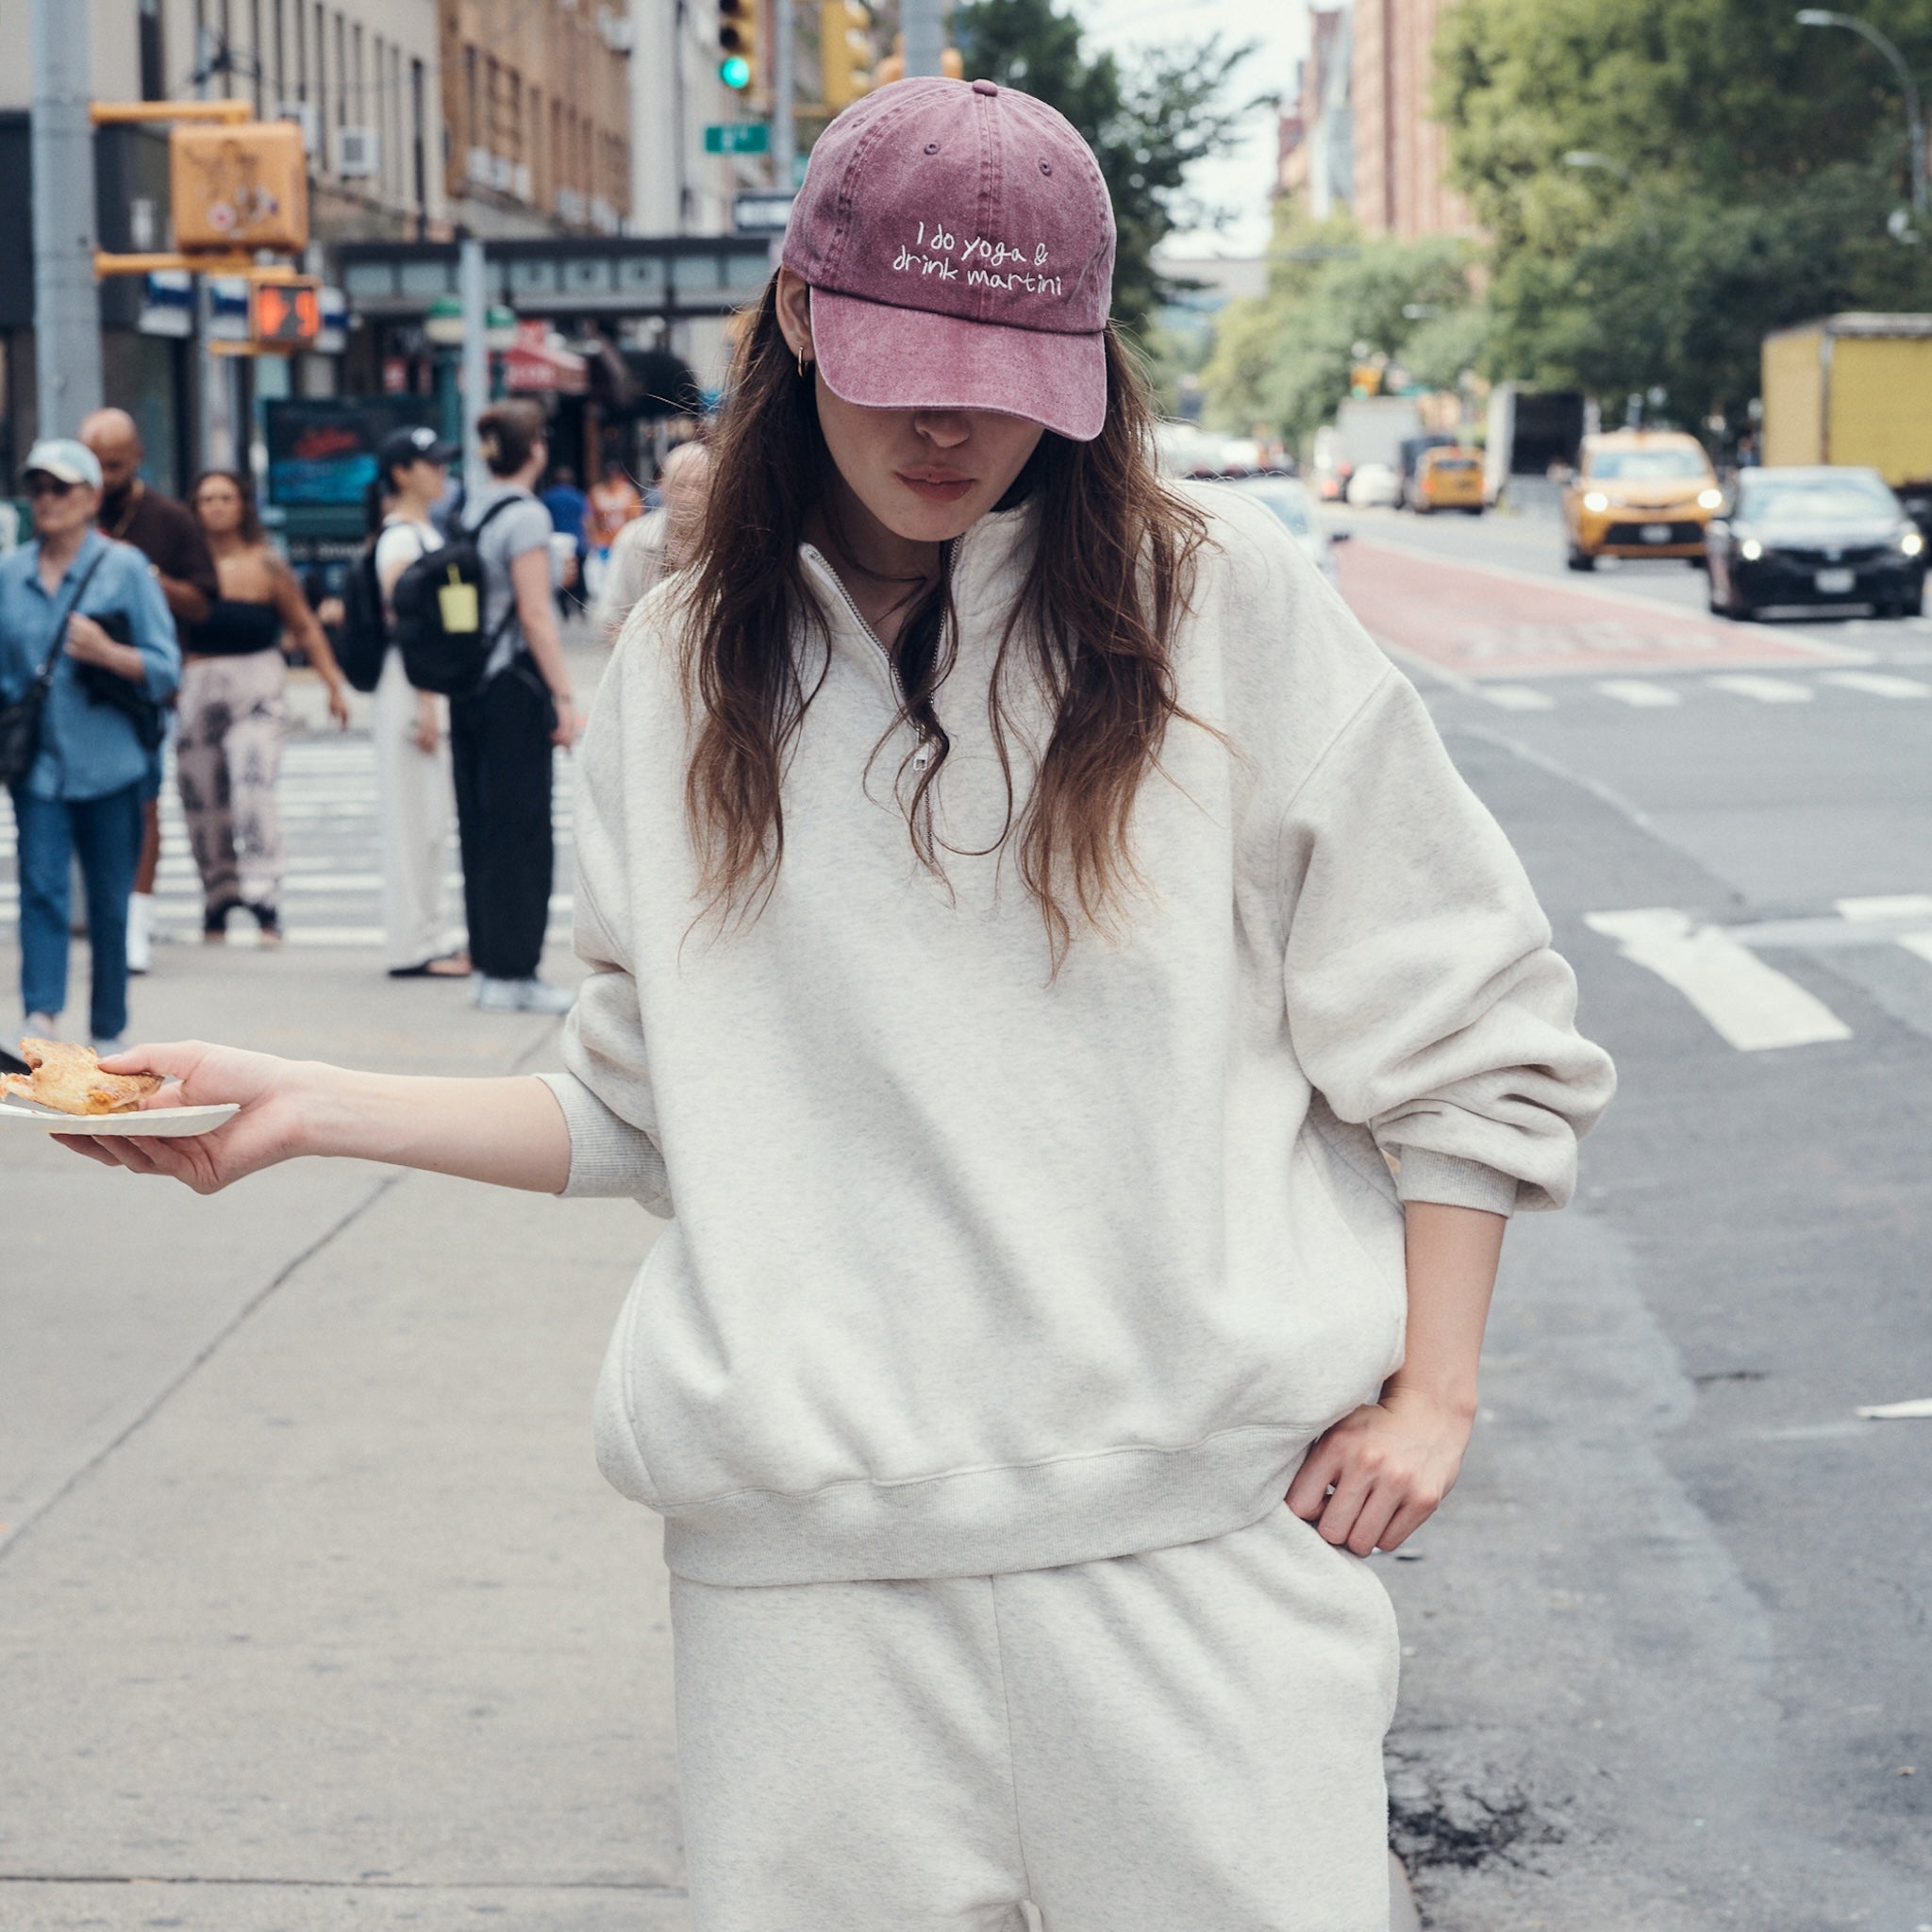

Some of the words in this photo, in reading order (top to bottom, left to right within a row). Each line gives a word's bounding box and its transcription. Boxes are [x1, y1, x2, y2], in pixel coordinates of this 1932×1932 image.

[916, 221, 924, 245] I
[930, 224, 956, 251] do
[960, 236, 1027, 267] yoga
[1033, 242, 1049, 267] &
[892, 244, 958, 280] drink
[967, 270, 1062, 296] martini
